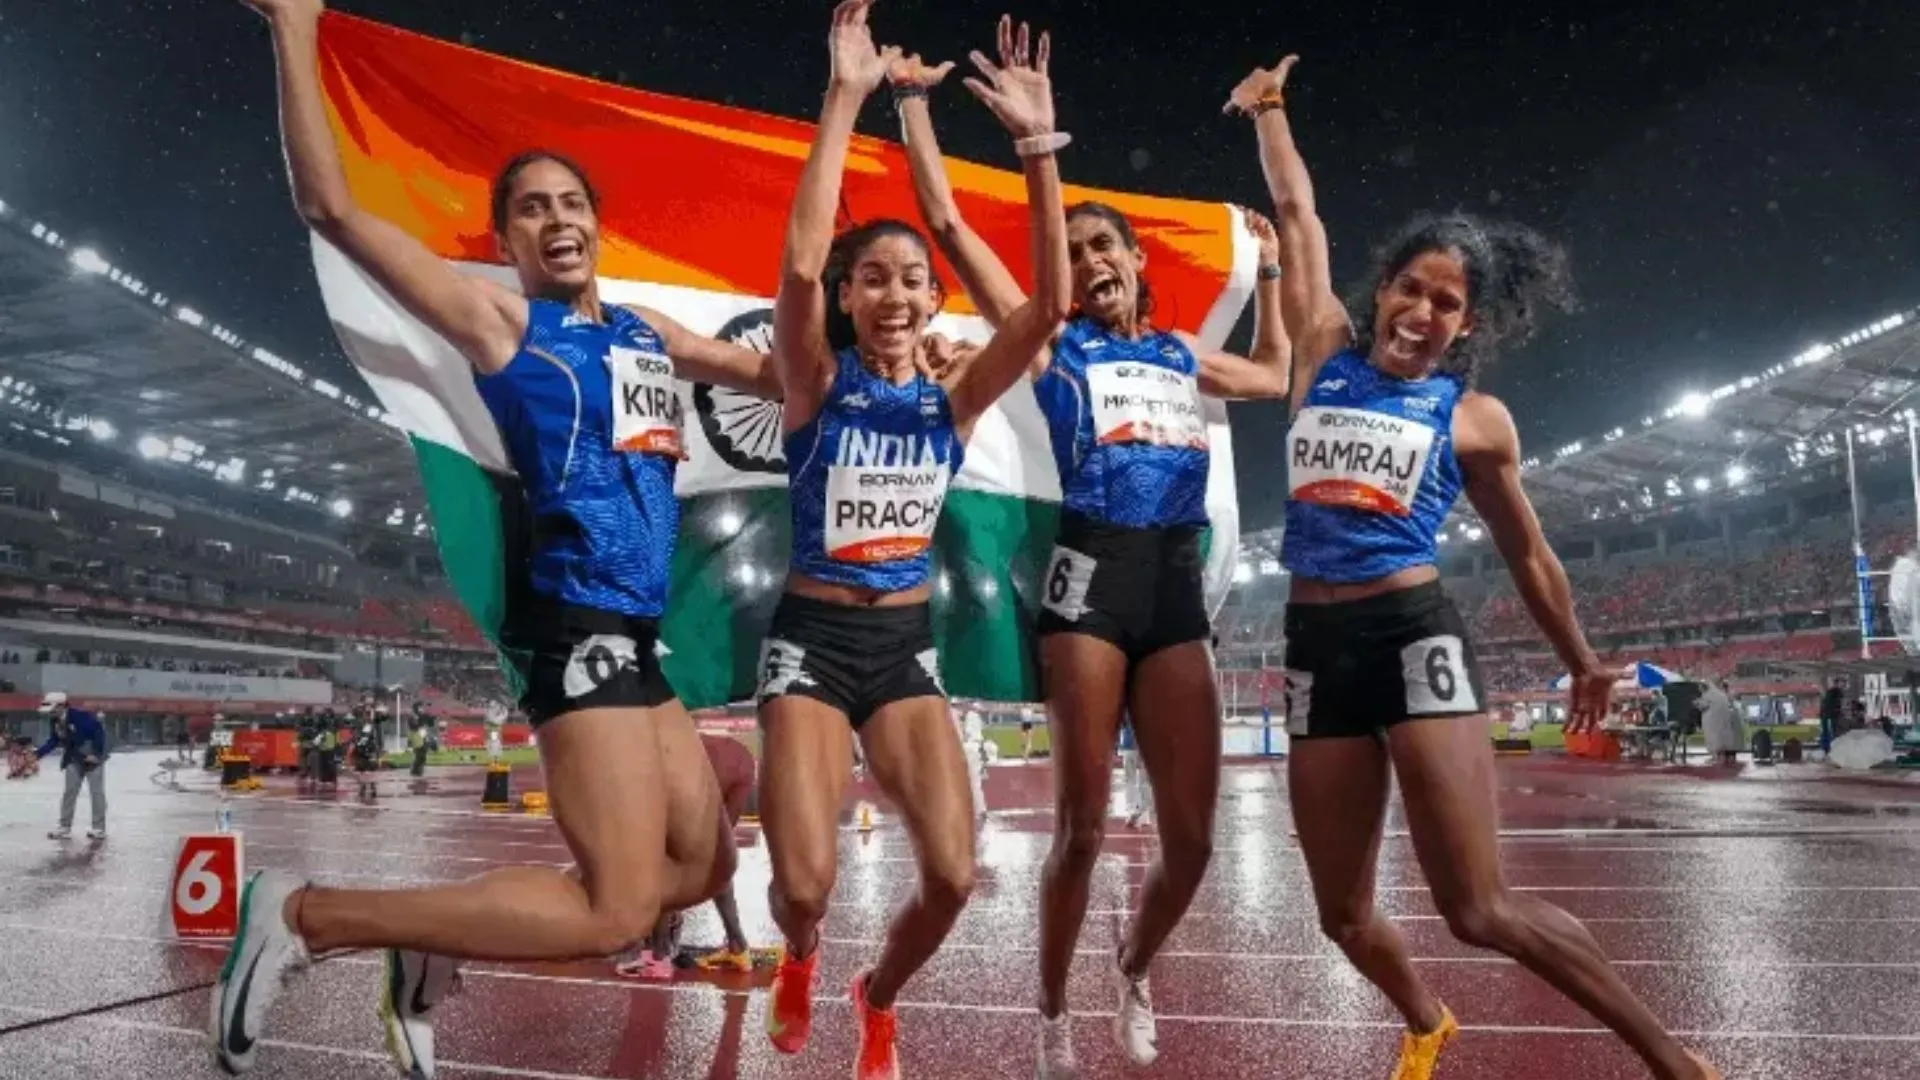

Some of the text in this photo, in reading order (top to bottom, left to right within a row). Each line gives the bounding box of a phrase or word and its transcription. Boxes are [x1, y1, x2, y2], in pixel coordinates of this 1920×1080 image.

[835, 426, 938, 467] INDIA
[1294, 437, 1417, 480] RAMRAJ
[1049, 558, 1071, 603] 6
[1425, 645, 1455, 701] 6
[176, 850, 221, 914] 6
